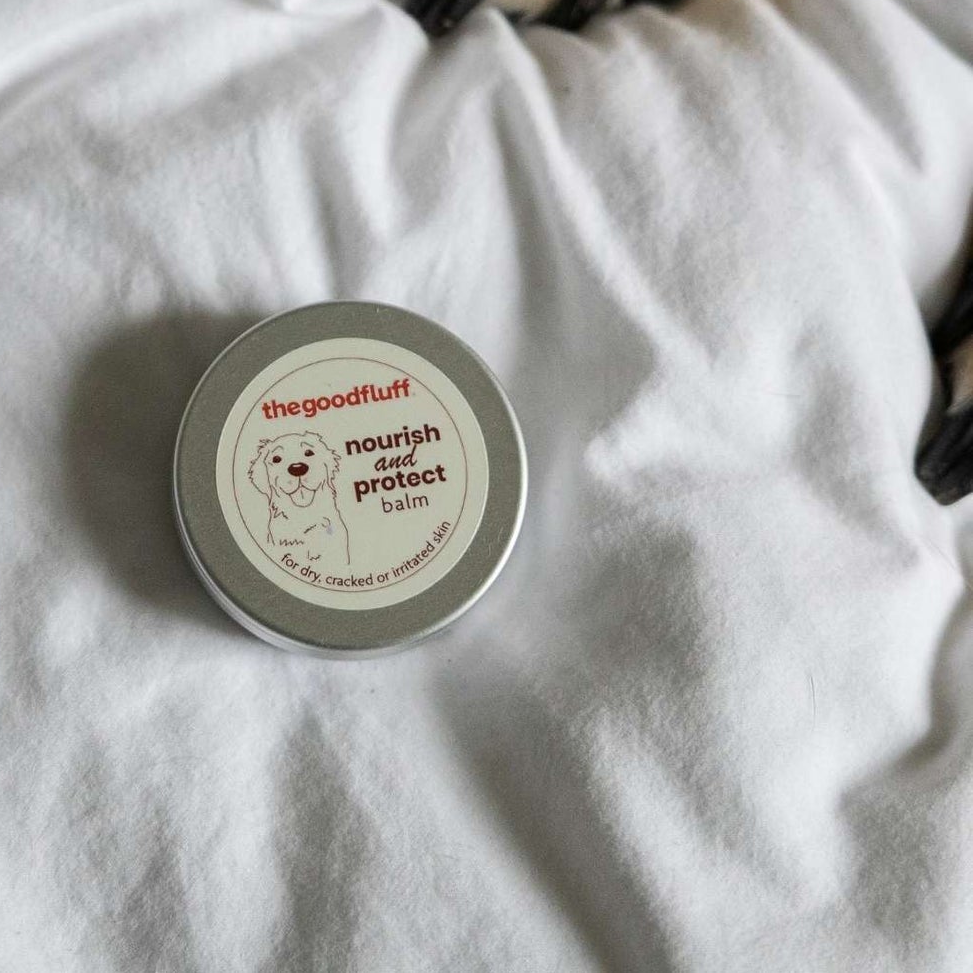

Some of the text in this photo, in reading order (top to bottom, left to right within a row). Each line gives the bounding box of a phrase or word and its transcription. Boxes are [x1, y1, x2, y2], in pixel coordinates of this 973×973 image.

[261, 378, 411, 420] thegoodfluff
[344, 423, 442, 456] nourish
[374, 443, 418, 472] and
[353, 464, 447, 503] protect
[381, 492, 430, 514] balm
[281, 520, 452, 588] for dry, cracked or irritated skin
